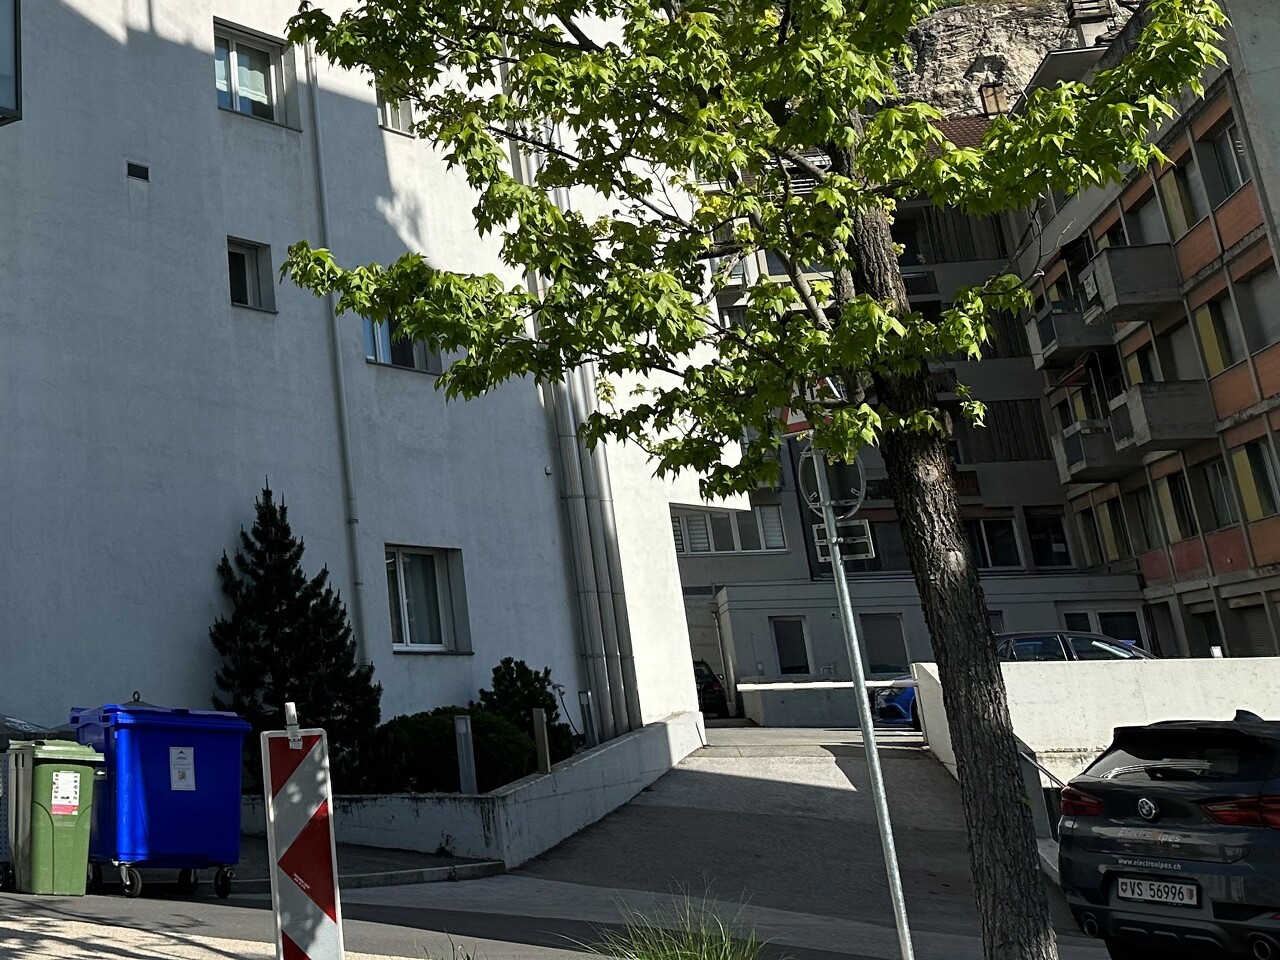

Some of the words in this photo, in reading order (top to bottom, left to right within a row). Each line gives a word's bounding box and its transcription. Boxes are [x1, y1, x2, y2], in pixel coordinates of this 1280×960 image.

[1118, 859, 1182, 870] www.electroalpes.ch
[1129, 881, 1143, 897] VS
[1149, 883, 1184, 901] 56996
